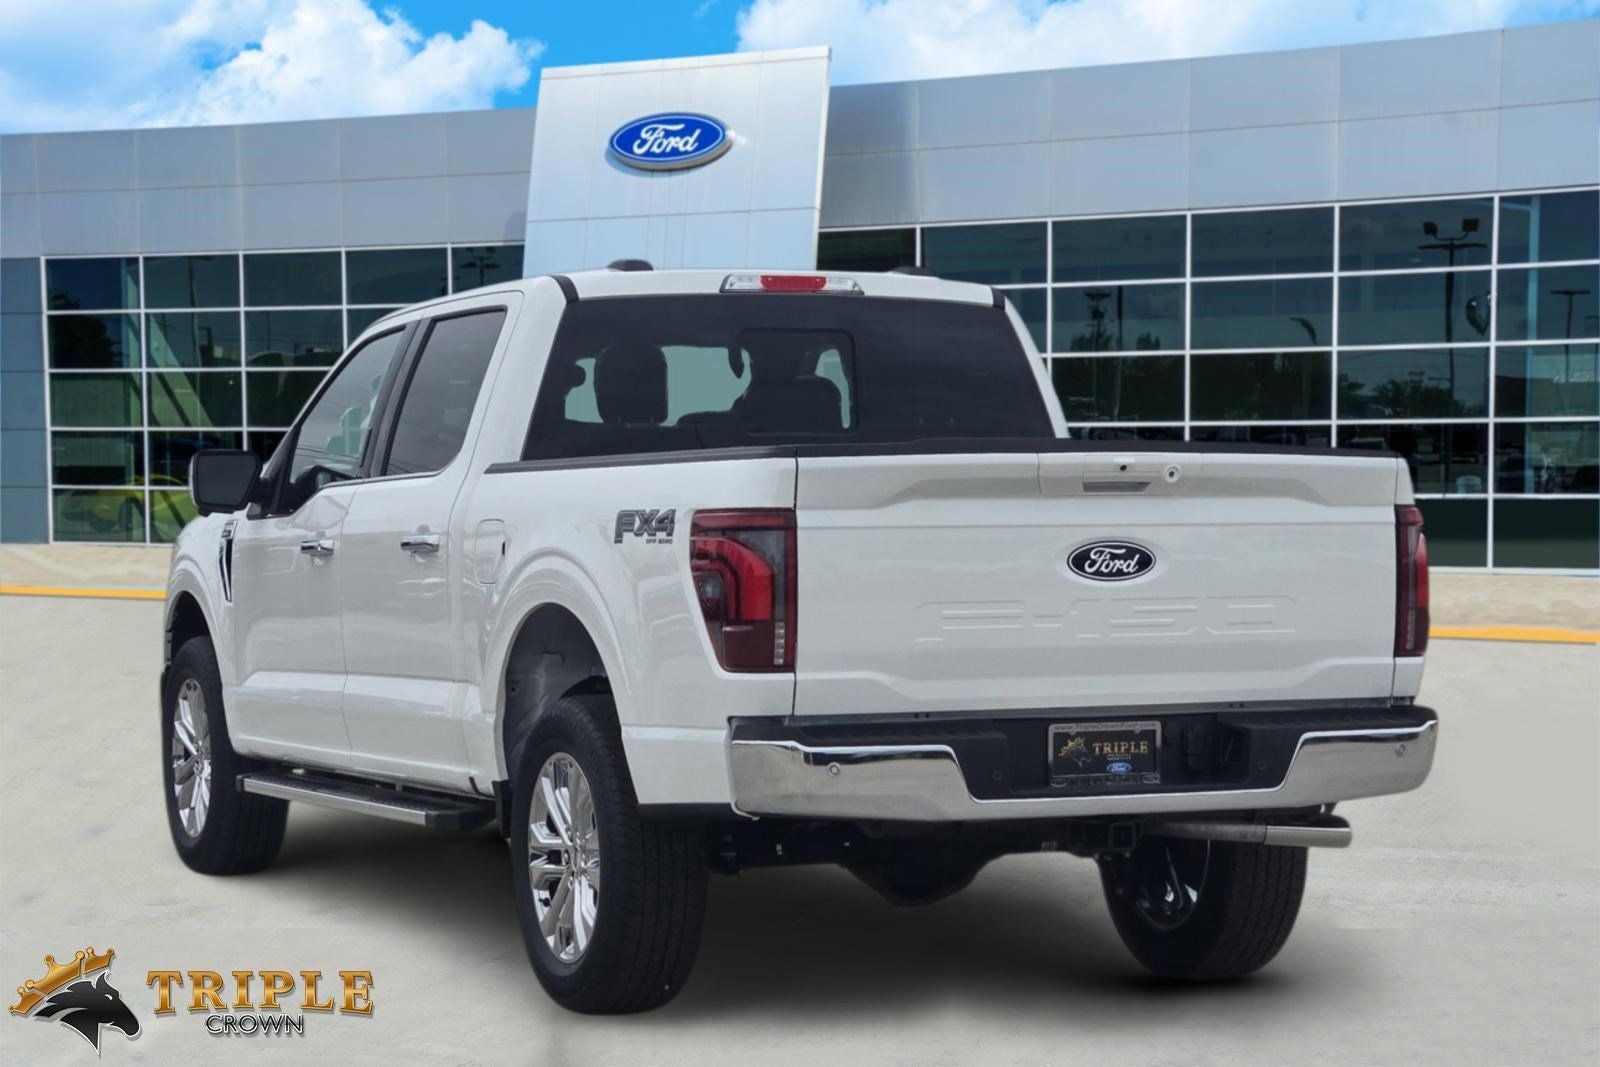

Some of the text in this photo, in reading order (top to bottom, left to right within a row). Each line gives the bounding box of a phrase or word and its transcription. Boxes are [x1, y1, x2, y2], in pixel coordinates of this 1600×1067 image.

[633, 123, 701, 155] Ford
[614, 508, 676, 544] FX4
[1084, 547, 1140, 573] Ford
[1092, 741, 1149, 755] TRIPLE
